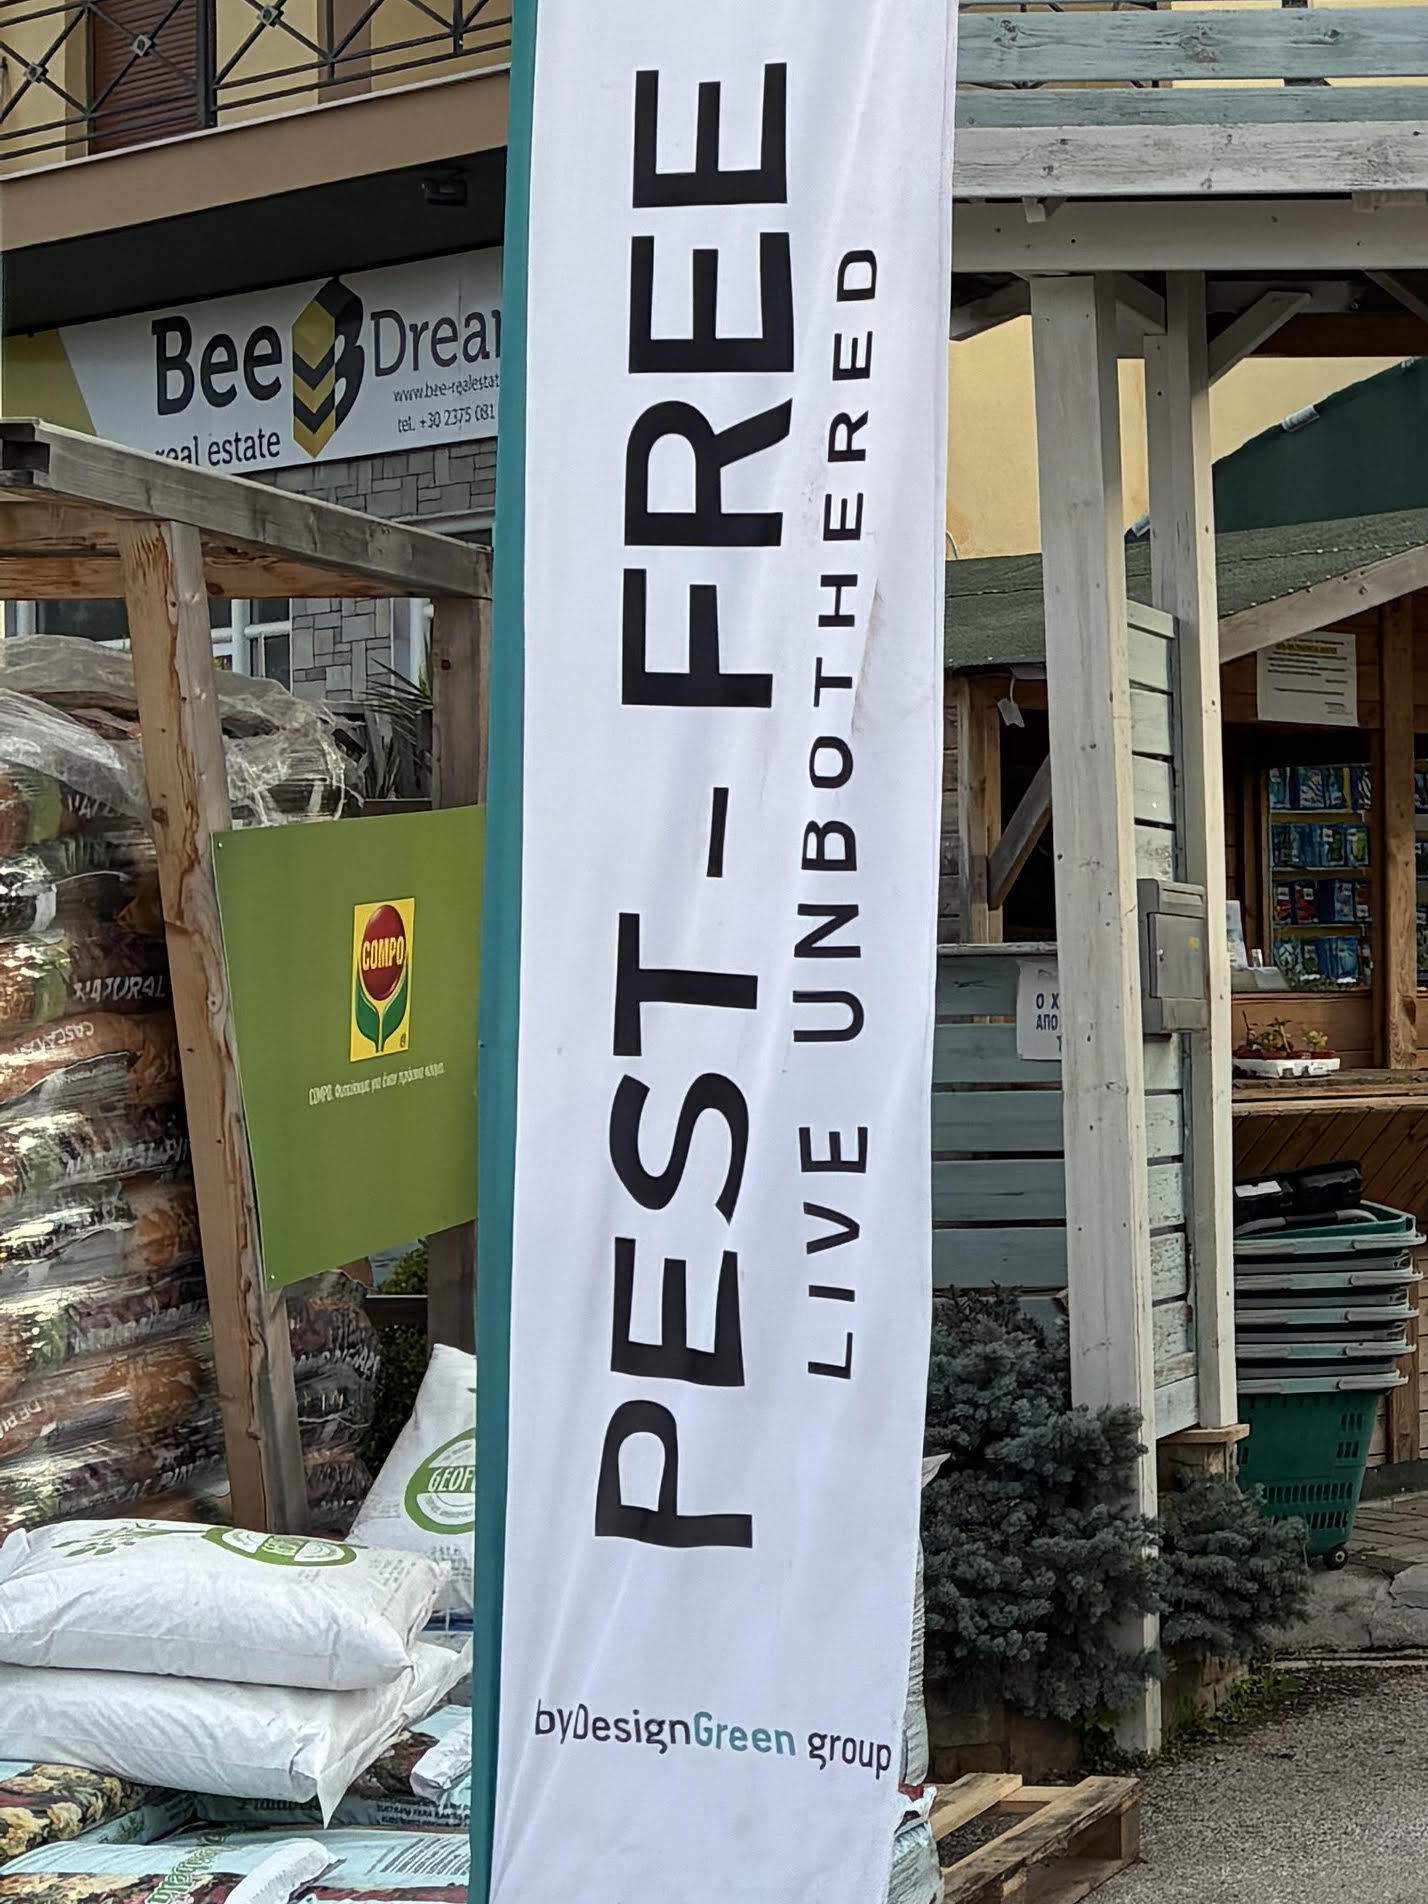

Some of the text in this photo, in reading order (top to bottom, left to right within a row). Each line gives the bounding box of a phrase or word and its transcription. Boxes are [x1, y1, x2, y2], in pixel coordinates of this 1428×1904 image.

[152, 309, 500, 416] Bee Drea
[208, 427, 281, 466] estate
[792, 247, 877, 1379] LIVE UNBOTHERED
[362, 935, 405, 971] COMPO
[808, 1731, 892, 1780] group
